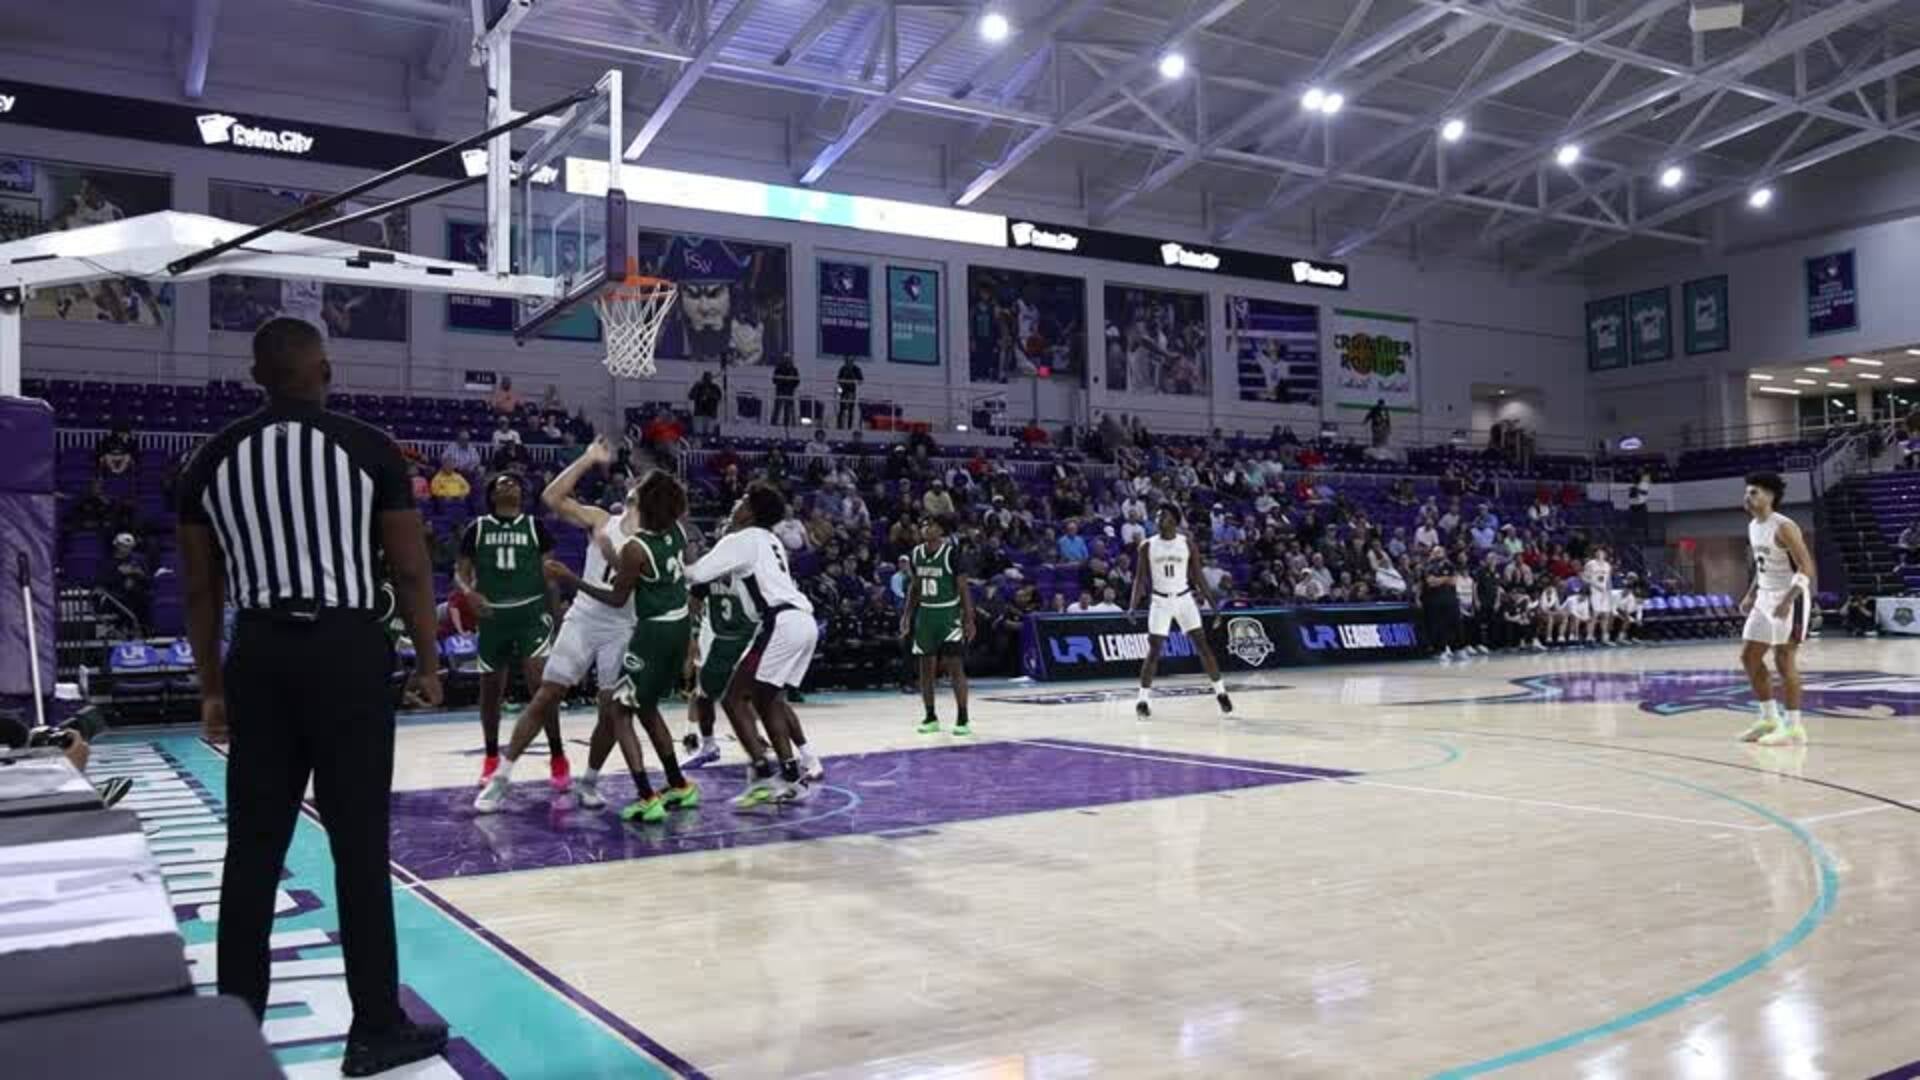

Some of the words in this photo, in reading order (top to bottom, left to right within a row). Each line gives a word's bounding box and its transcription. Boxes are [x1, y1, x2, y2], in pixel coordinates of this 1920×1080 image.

[485, 531, 528, 546] GRAYSON
[496, 547, 516, 569] 11
[1163, 564, 1176, 578] 11
[921, 578, 938, 596] 10
[721, 598, 732, 621] 3
